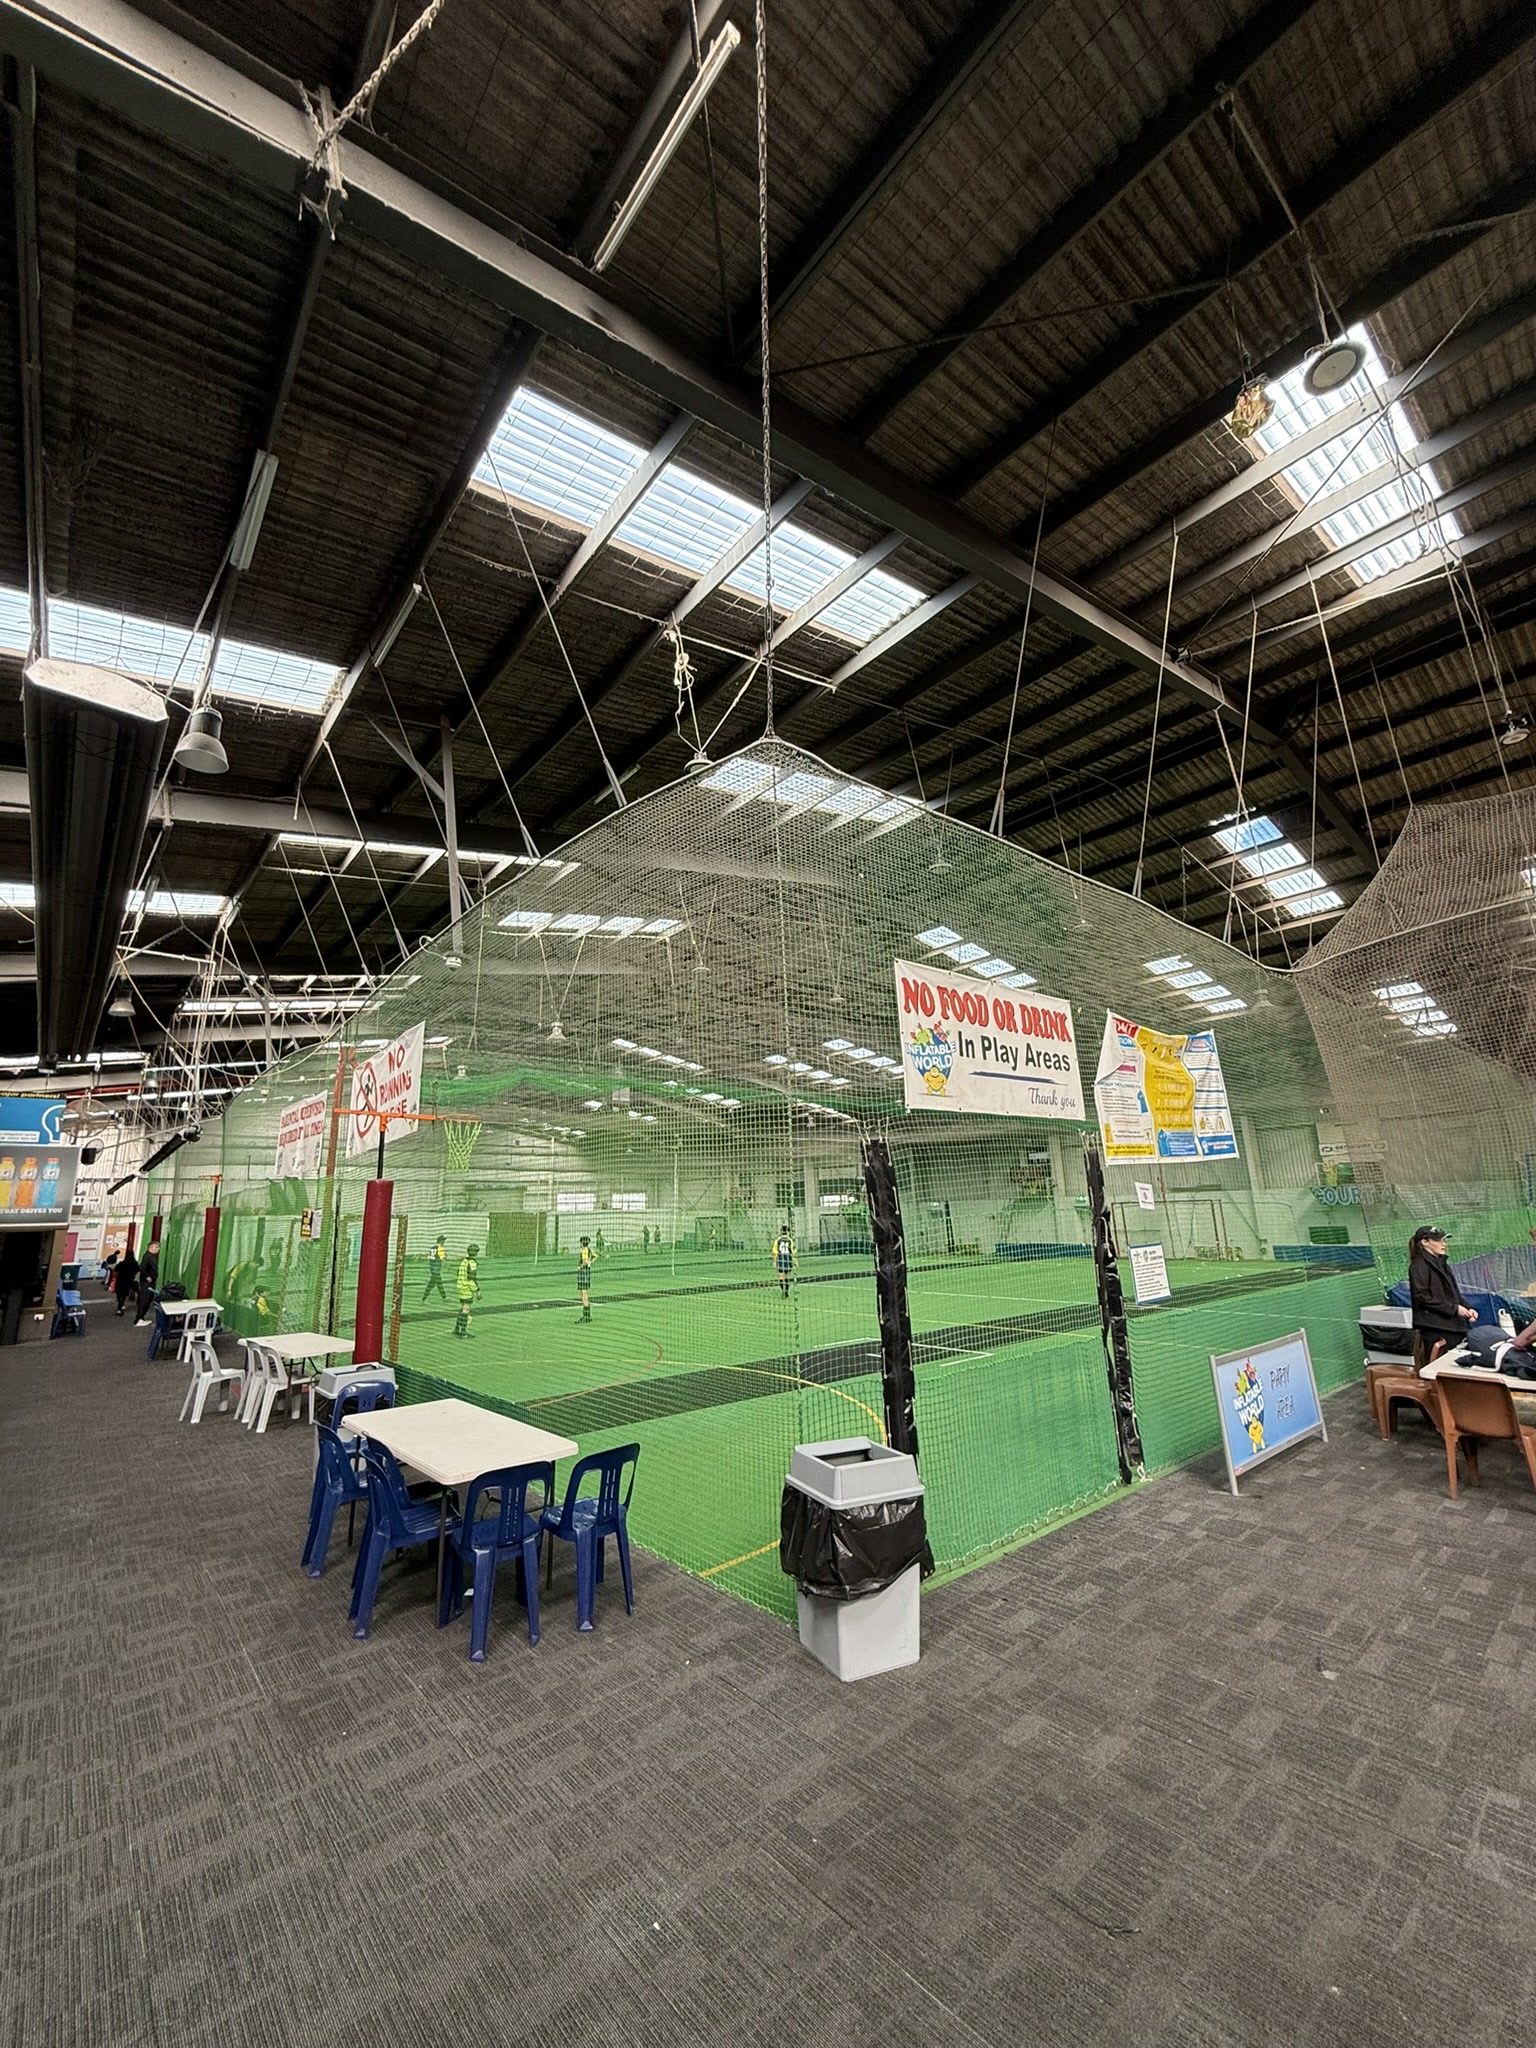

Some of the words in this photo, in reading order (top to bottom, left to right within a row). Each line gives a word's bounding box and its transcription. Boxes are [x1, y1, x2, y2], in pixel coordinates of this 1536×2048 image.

[901, 977, 936, 1017] NO
[936, 985, 990, 1028] FOOD
[993, 998, 1019, 1034] OR
[1019, 1003, 1073, 1042] DRINK
[388, 1044, 406, 1074] NO
[905, 1041, 957, 1056] INFLATABLE
[912, 1055, 954, 1071] WORLD
[957, 1030, 976, 1059] In
[980, 1035, 1019, 1072] Play
[1025, 1042, 1071, 1072] Areas
[1028, 1087, 1058, 1105] Thank
[1060, 1096, 1077, 1111] you
[1232, 1377, 1264, 1412] INFLATABLE
[1276, 1394, 1295, 1421] AREA
[1239, 1395, 1265, 1427] WORLD
